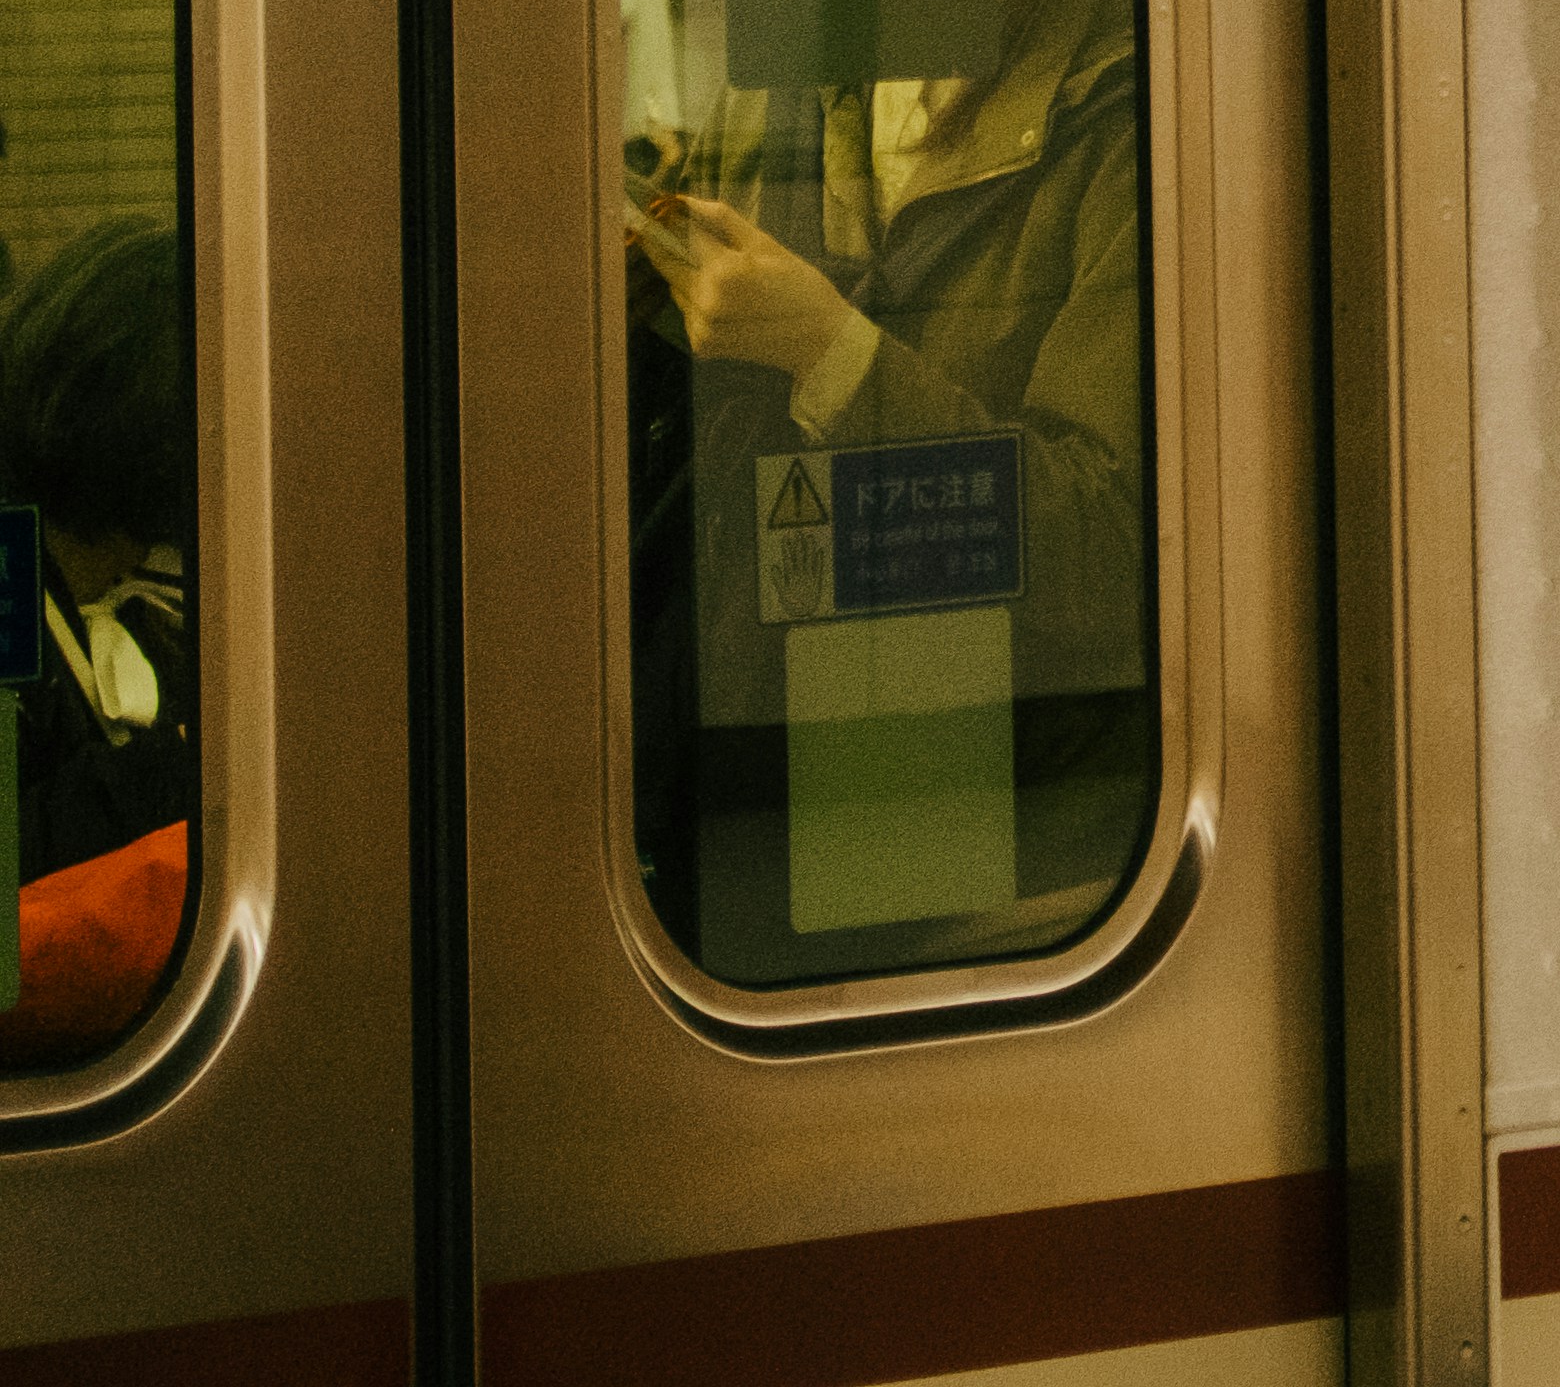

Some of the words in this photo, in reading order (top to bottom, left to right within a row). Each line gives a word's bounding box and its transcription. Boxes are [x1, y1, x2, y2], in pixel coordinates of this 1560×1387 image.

[856, 471, 996, 516] ドアに注意
